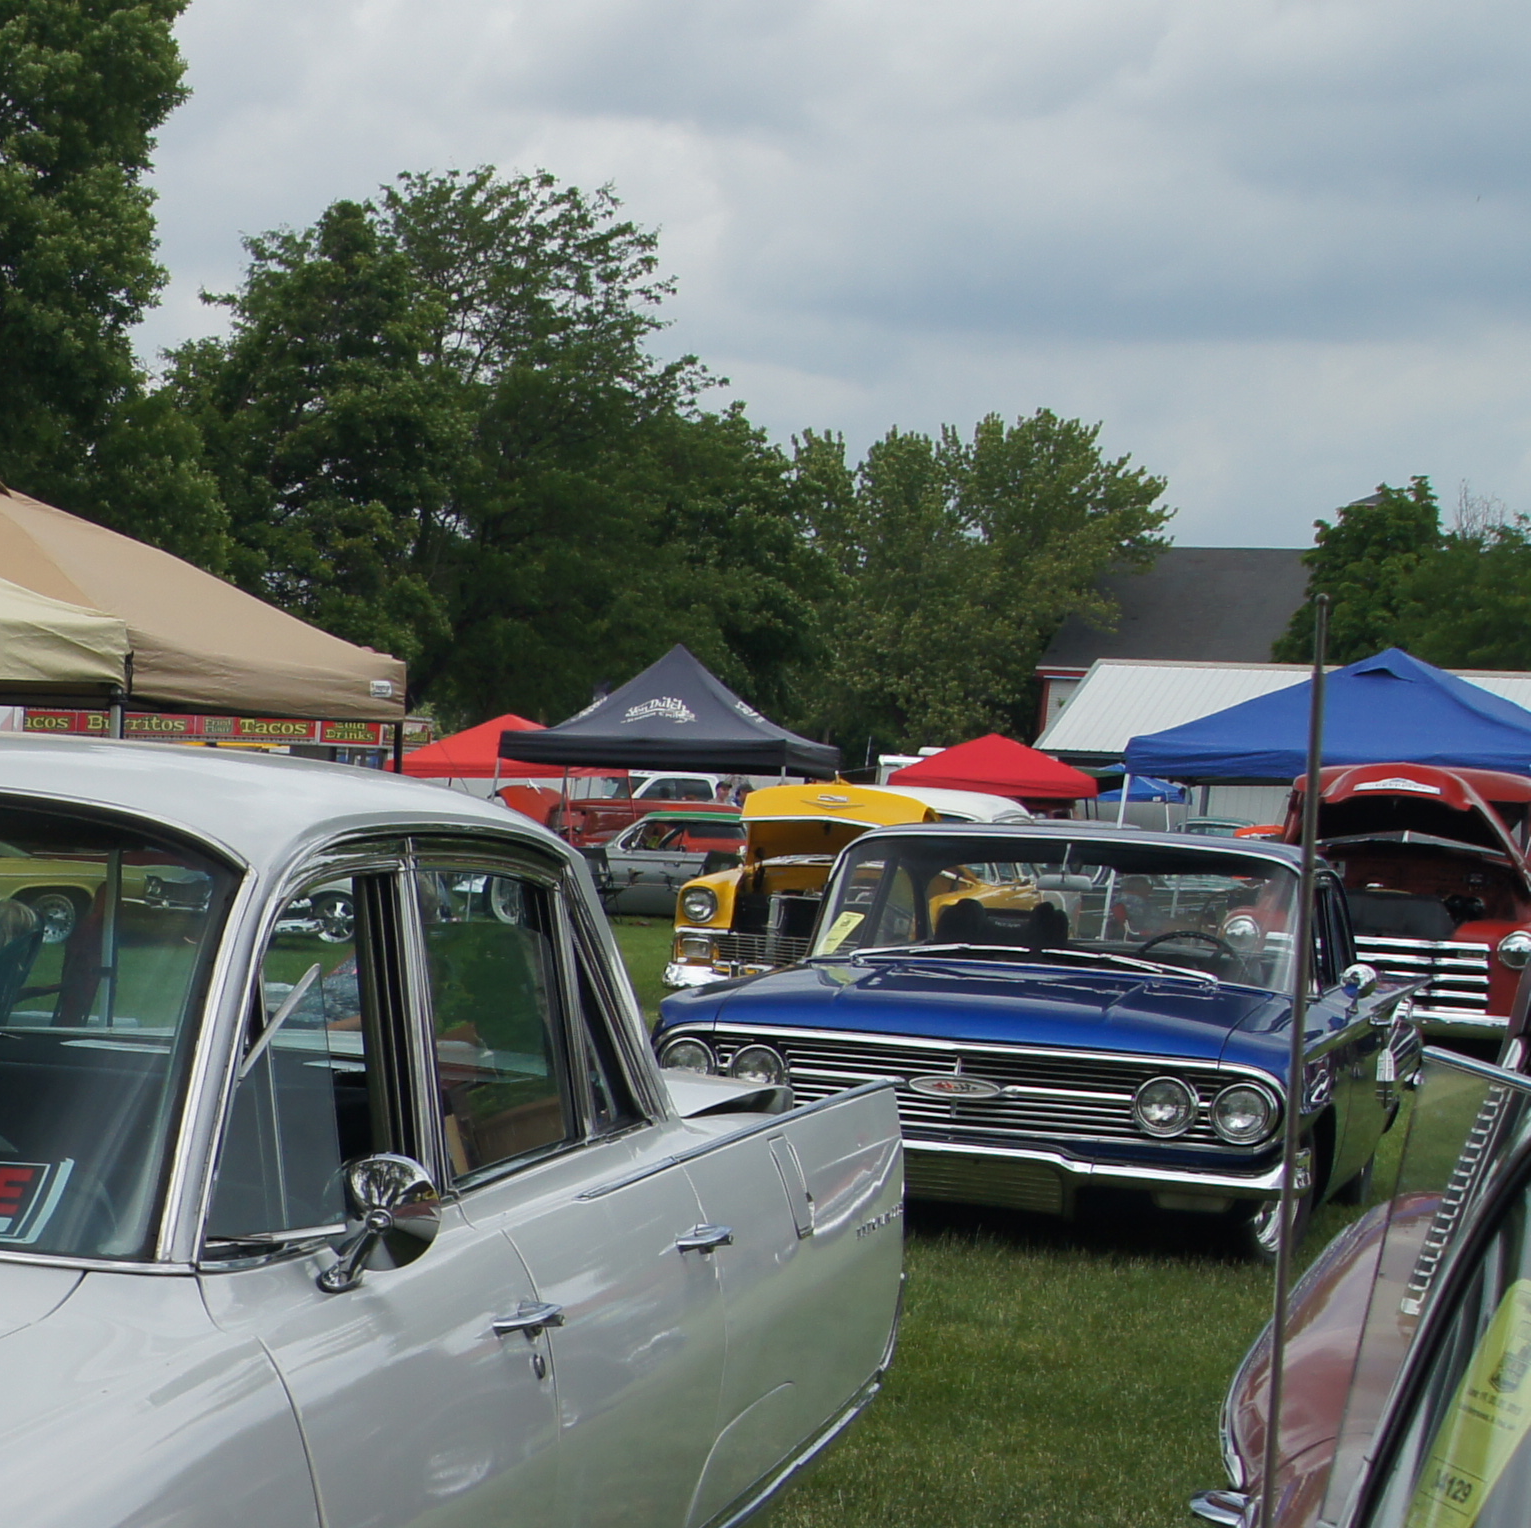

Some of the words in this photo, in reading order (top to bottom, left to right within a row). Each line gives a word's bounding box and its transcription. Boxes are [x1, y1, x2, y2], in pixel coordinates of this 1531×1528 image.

[25, 715, 69, 729] acos
[239, 718, 308, 735] Tacos
[325, 728, 374, 741] Drinks
